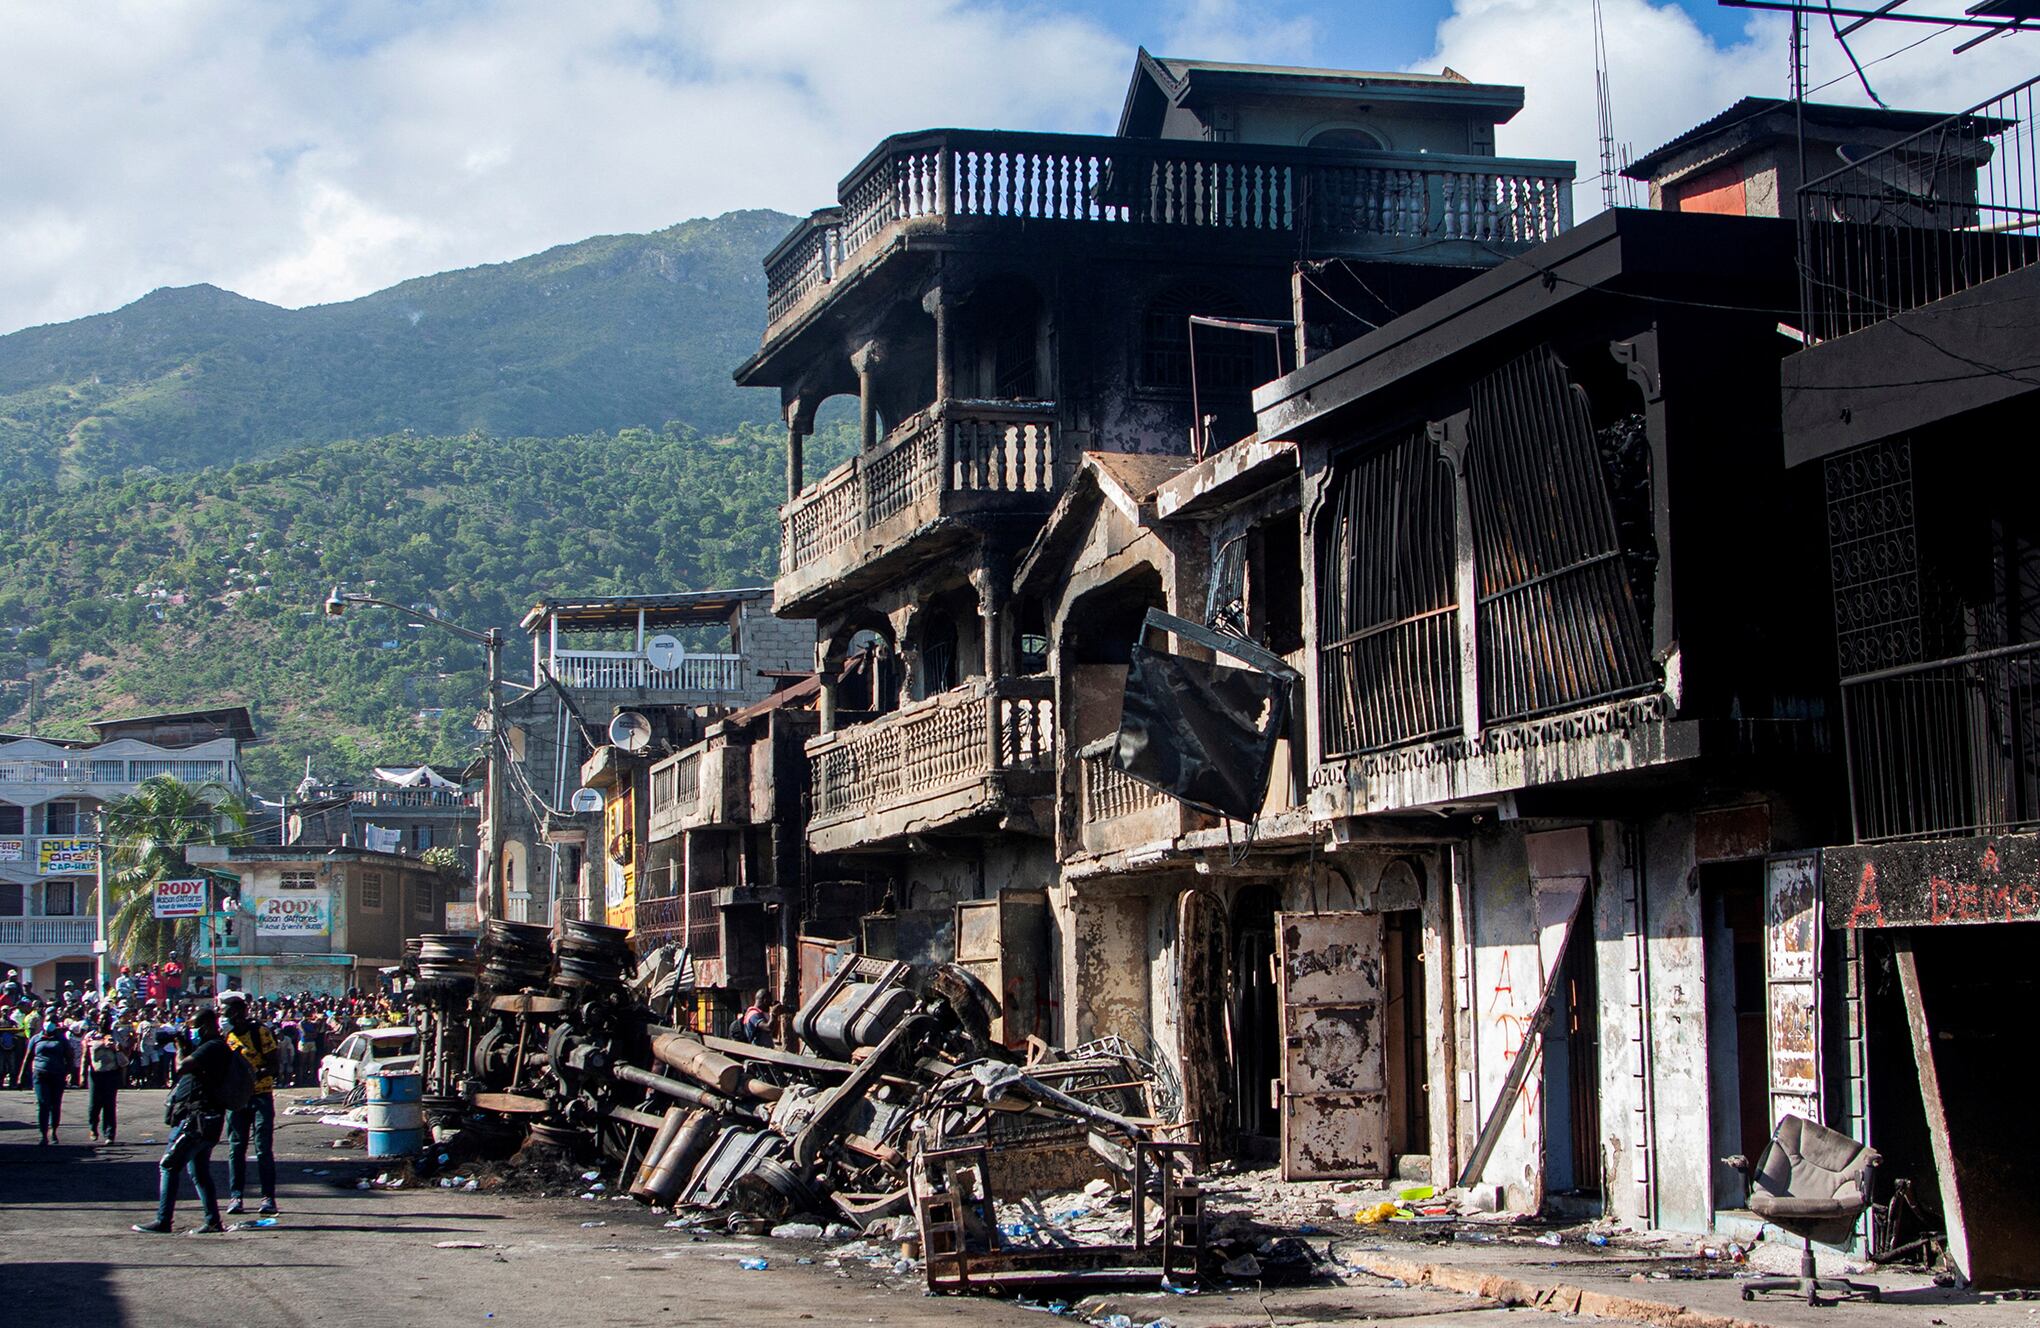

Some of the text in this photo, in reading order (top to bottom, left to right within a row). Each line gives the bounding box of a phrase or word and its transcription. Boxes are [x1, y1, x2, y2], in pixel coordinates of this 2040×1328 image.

[158, 881, 203, 896] RODY
[1847, 862, 1884, 928] A
[1489, 950, 1514, 1016] A
